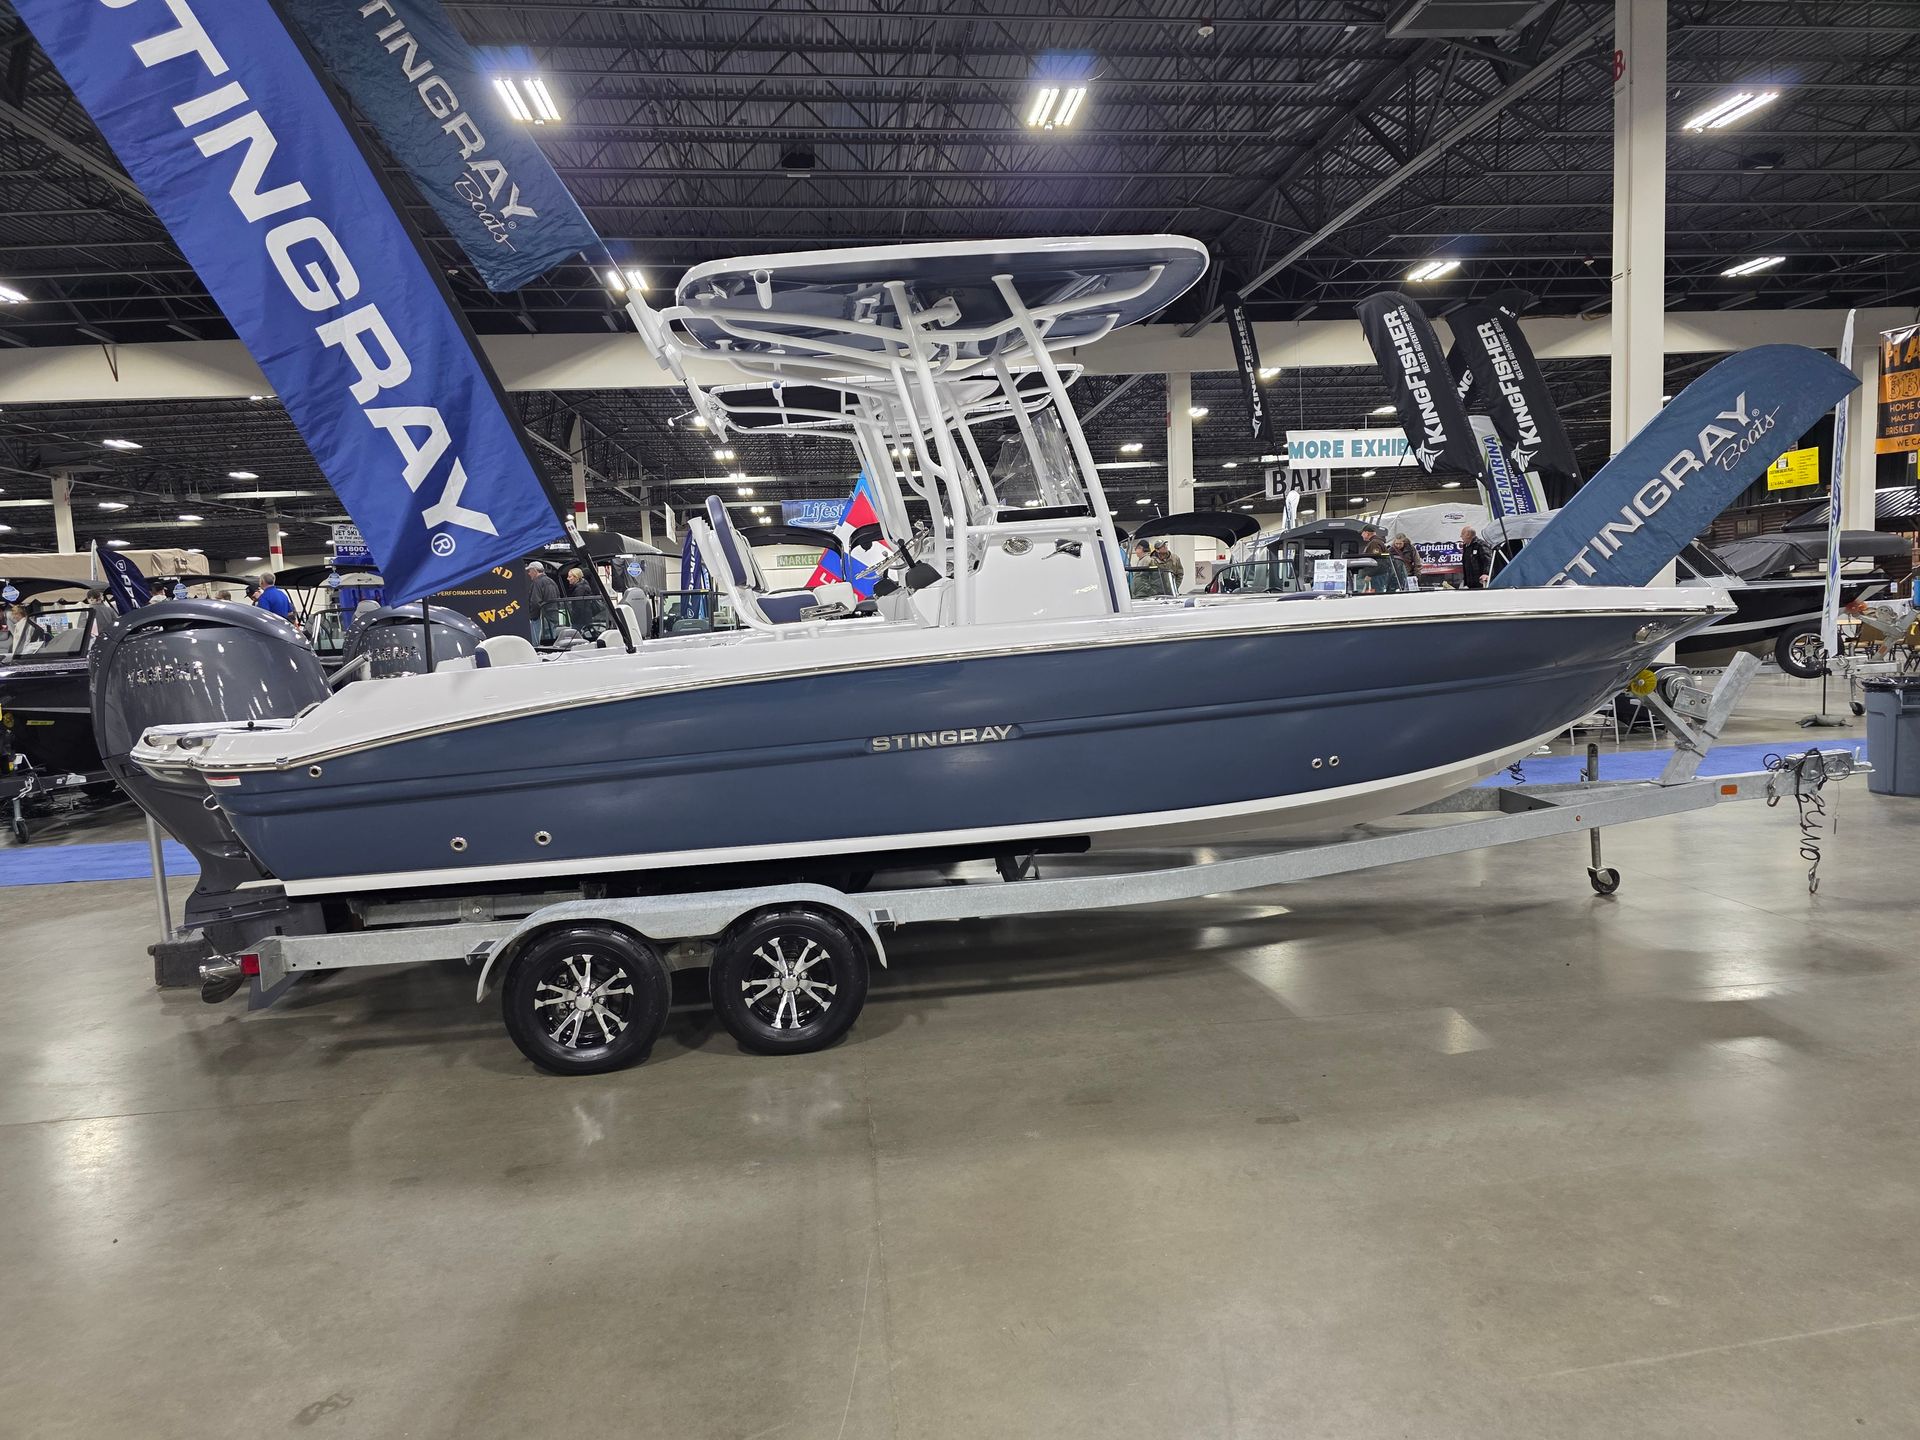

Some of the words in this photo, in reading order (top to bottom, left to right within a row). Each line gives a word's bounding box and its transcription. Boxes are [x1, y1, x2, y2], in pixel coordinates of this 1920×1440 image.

[454, 171, 518, 253] Boats
[100, 0, 499, 537] TINGRAY
[1383, 309, 1448, 445] KINGFISHER
[1476, 321, 1542, 446] KINGFISHER
[1889, 401, 1915, 413] HOME
[1890, 414, 1907, 424] MAC
[1714, 403, 1783, 472] Boats
[1885, 423, 1915, 436] BRISKET
[1896, 438, 1909, 447] WE
[1288, 440, 1345, 459] MORE
[1351, 438, 1415, 458] EXHIB
[1483, 436, 1511, 489] MARINA
[1273, 468, 1323, 496] BAR
[1414, 543, 1454, 555] Captains
[1438, 555, 1448, 563] &
[872, 725, 1013, 752] STINGRAY
